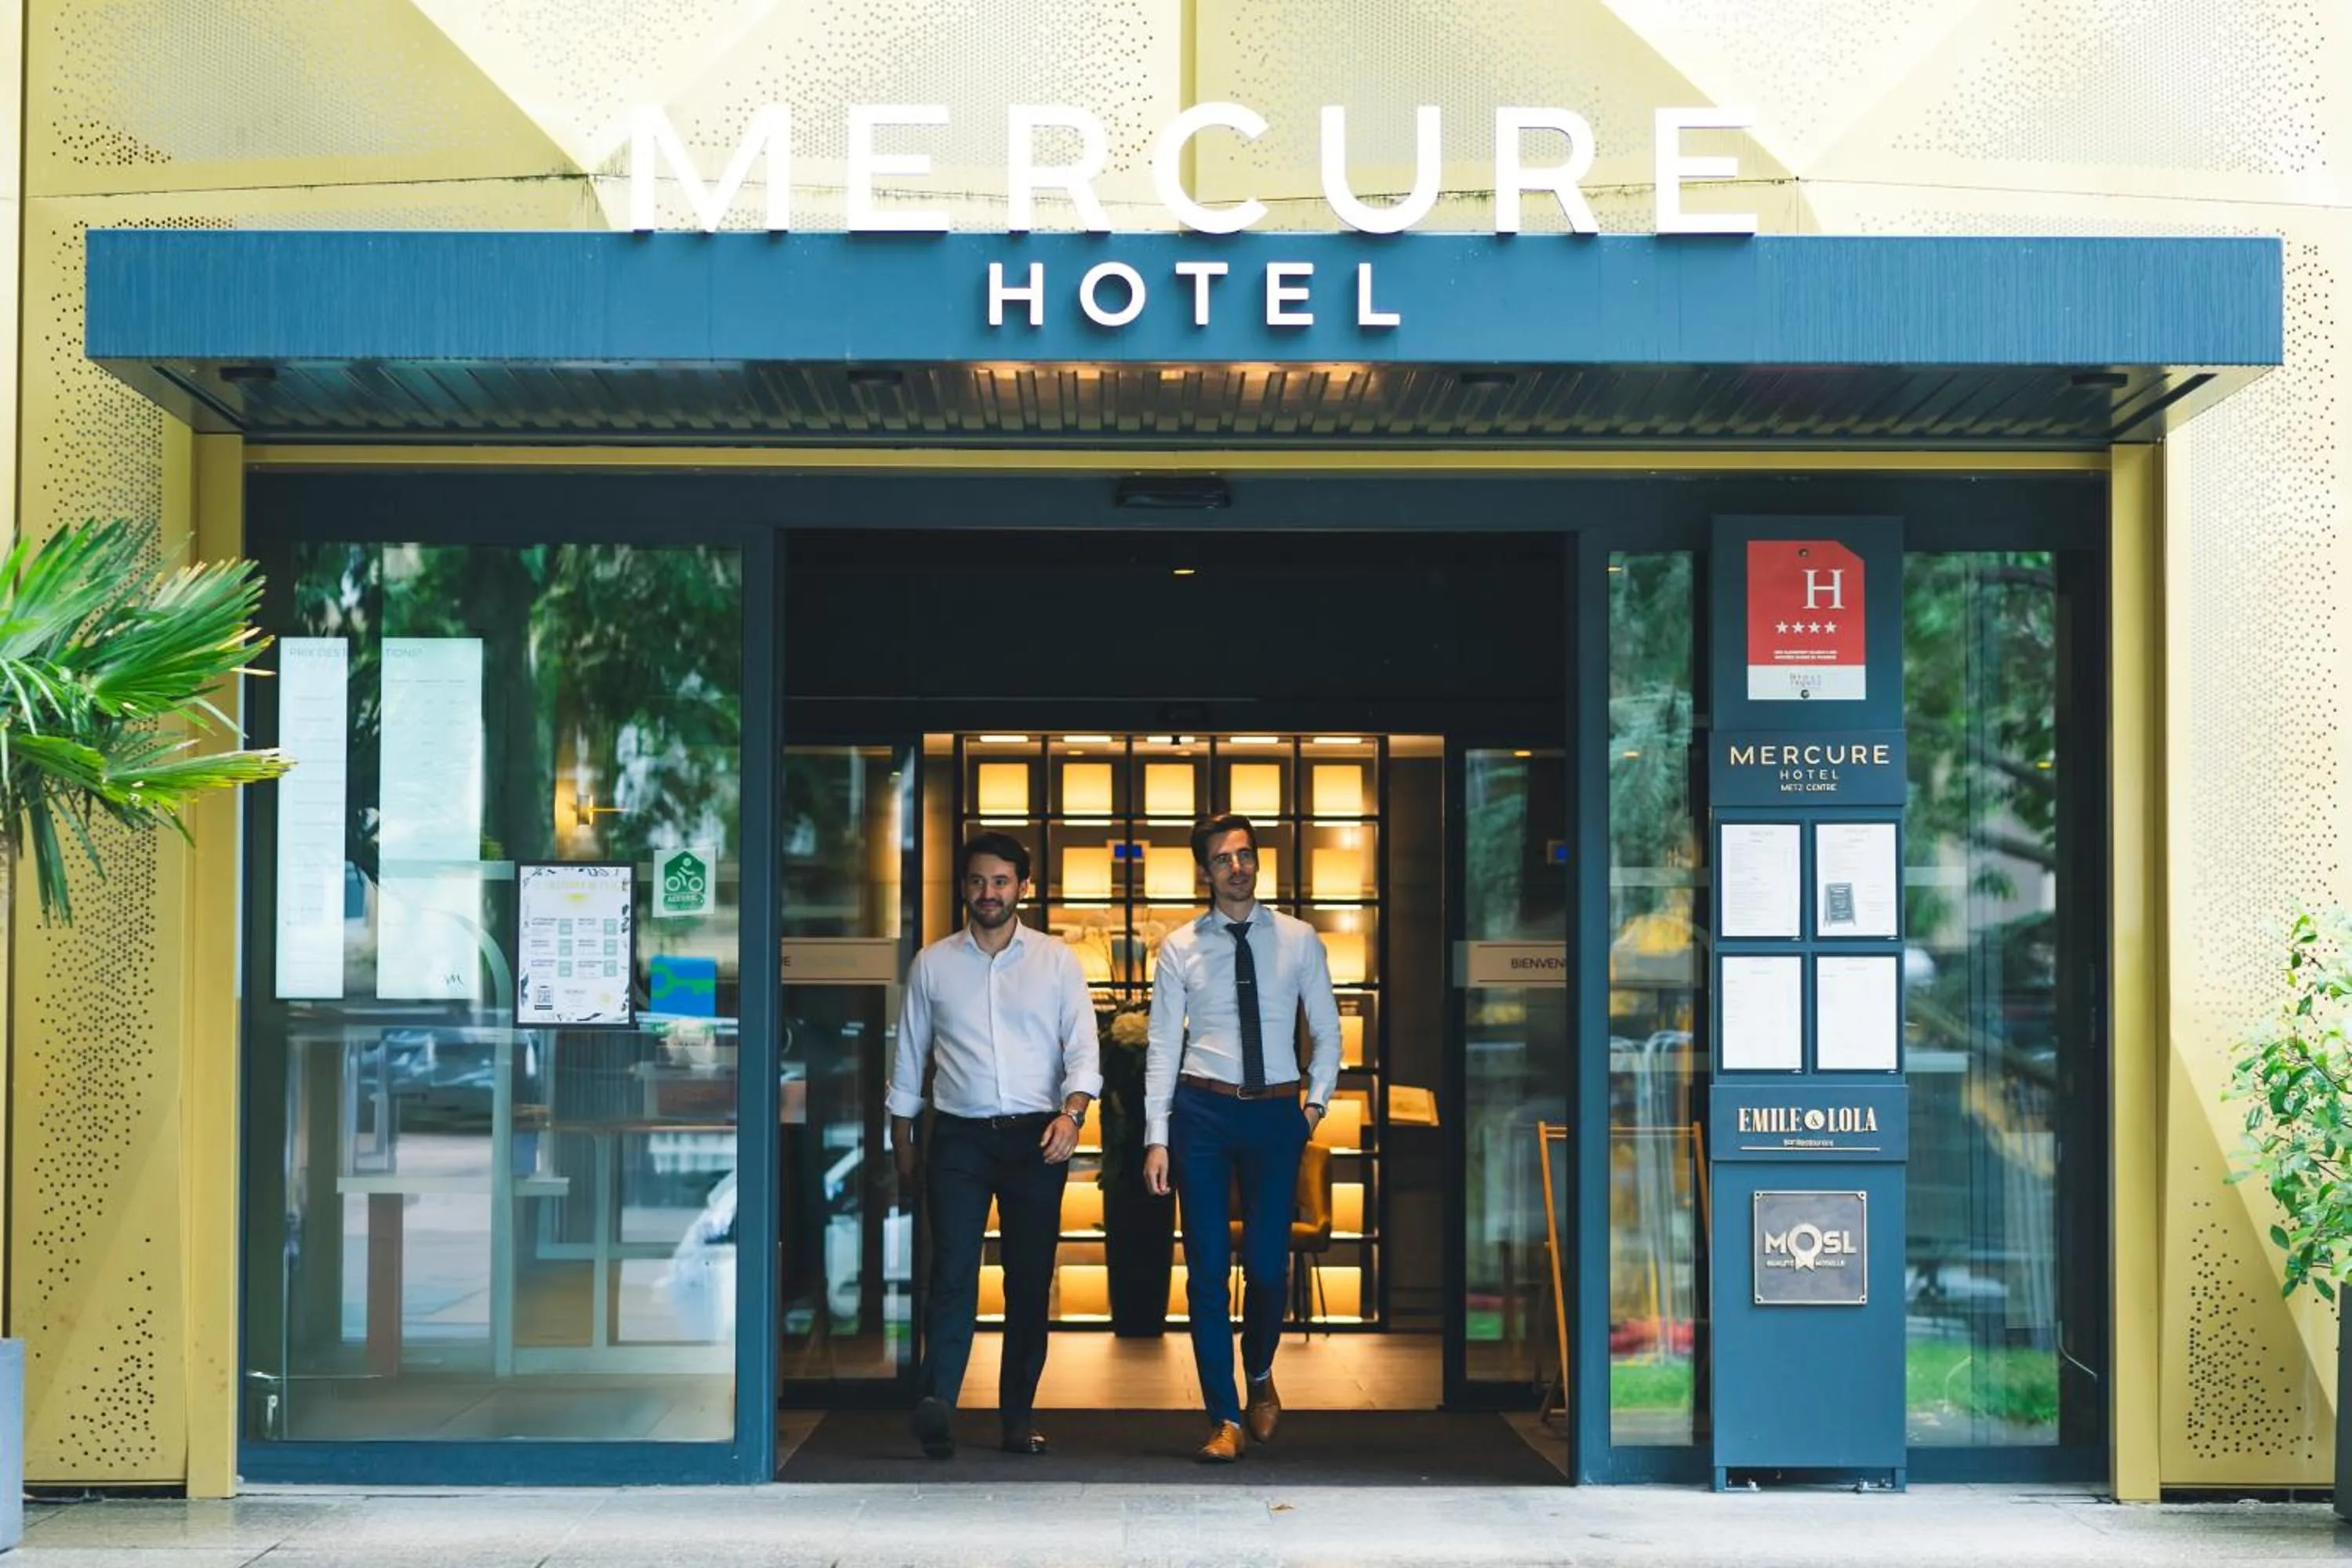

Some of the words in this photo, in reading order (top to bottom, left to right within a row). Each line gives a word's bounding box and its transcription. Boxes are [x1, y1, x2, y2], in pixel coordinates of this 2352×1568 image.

[630, 103, 1758, 234] MERCURE
[988, 261, 1401, 326] HOTEL
[1802, 568, 1845, 609] H
[1730, 745, 1890, 765] MERCURE
[1779, 769, 1839, 780] HOTEL
[1737, 1106, 1802, 1132] EMILE
[1828, 1106, 1878, 1132] LOLA
[1764, 1223, 1857, 1258] MOSL
